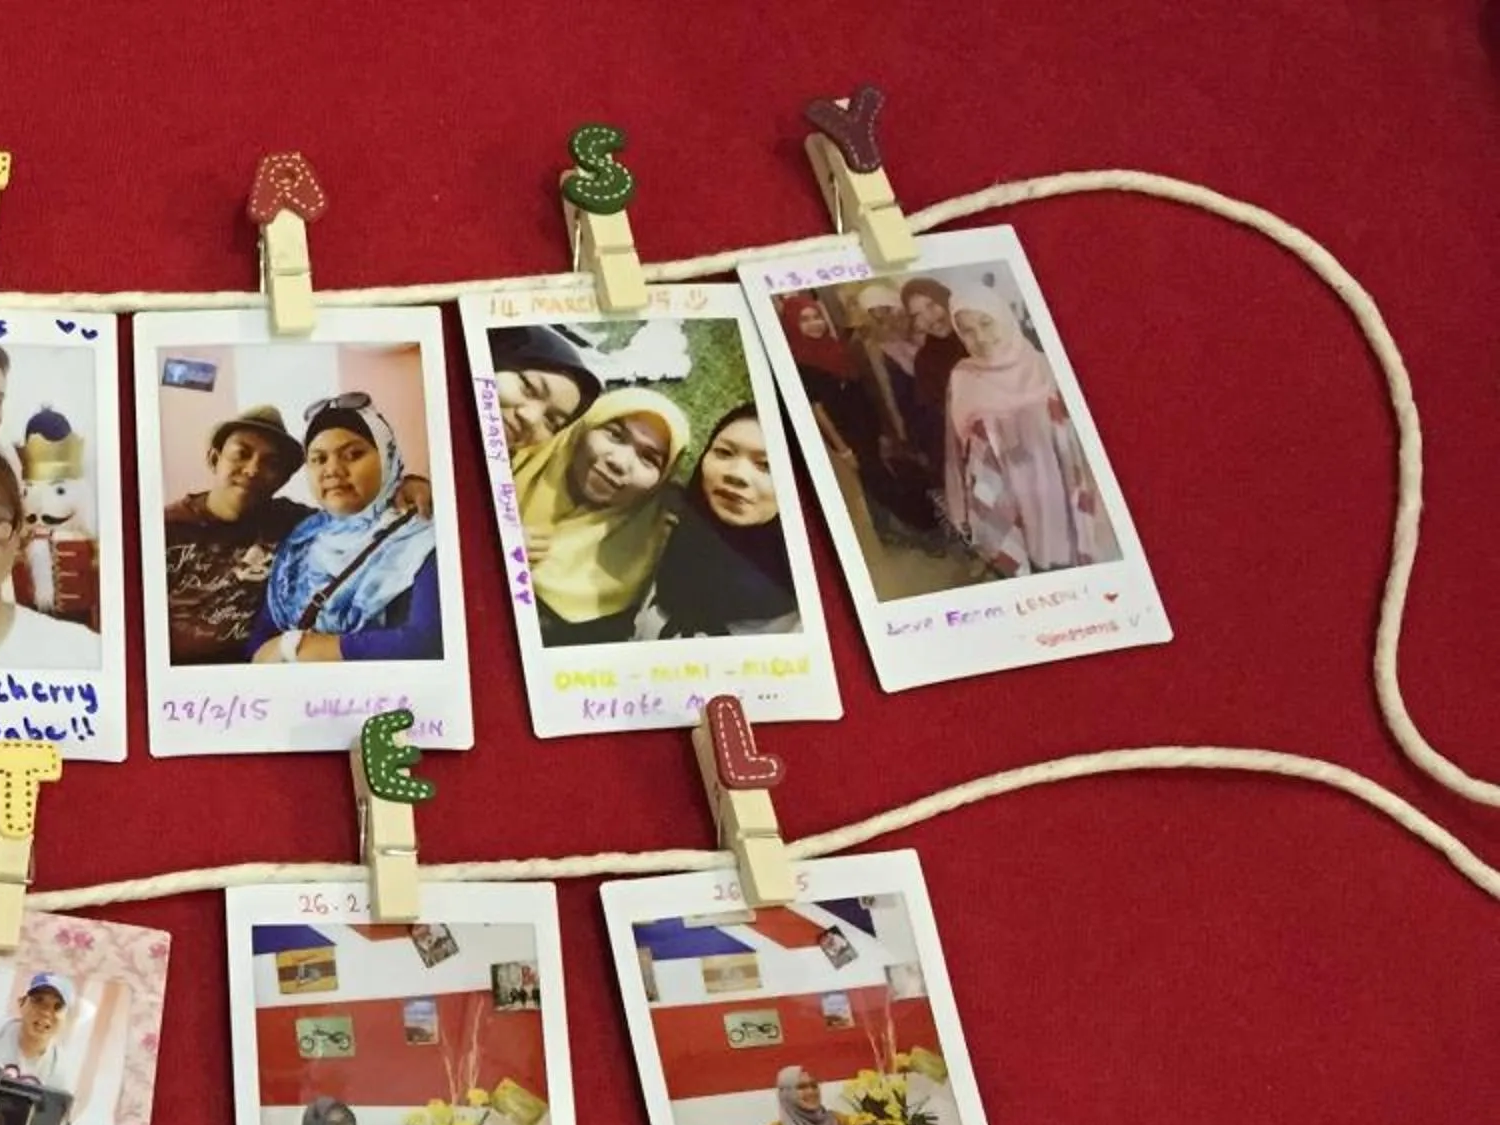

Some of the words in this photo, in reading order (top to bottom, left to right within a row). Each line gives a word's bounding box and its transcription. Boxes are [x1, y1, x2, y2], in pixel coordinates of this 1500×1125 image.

[561, 122, 636, 214] S
[806, 85, 886, 174] Y
[162, 694, 273, 730] 28/2/15
[361, 708, 437, 804] E
[703, 694, 786, 790] L
